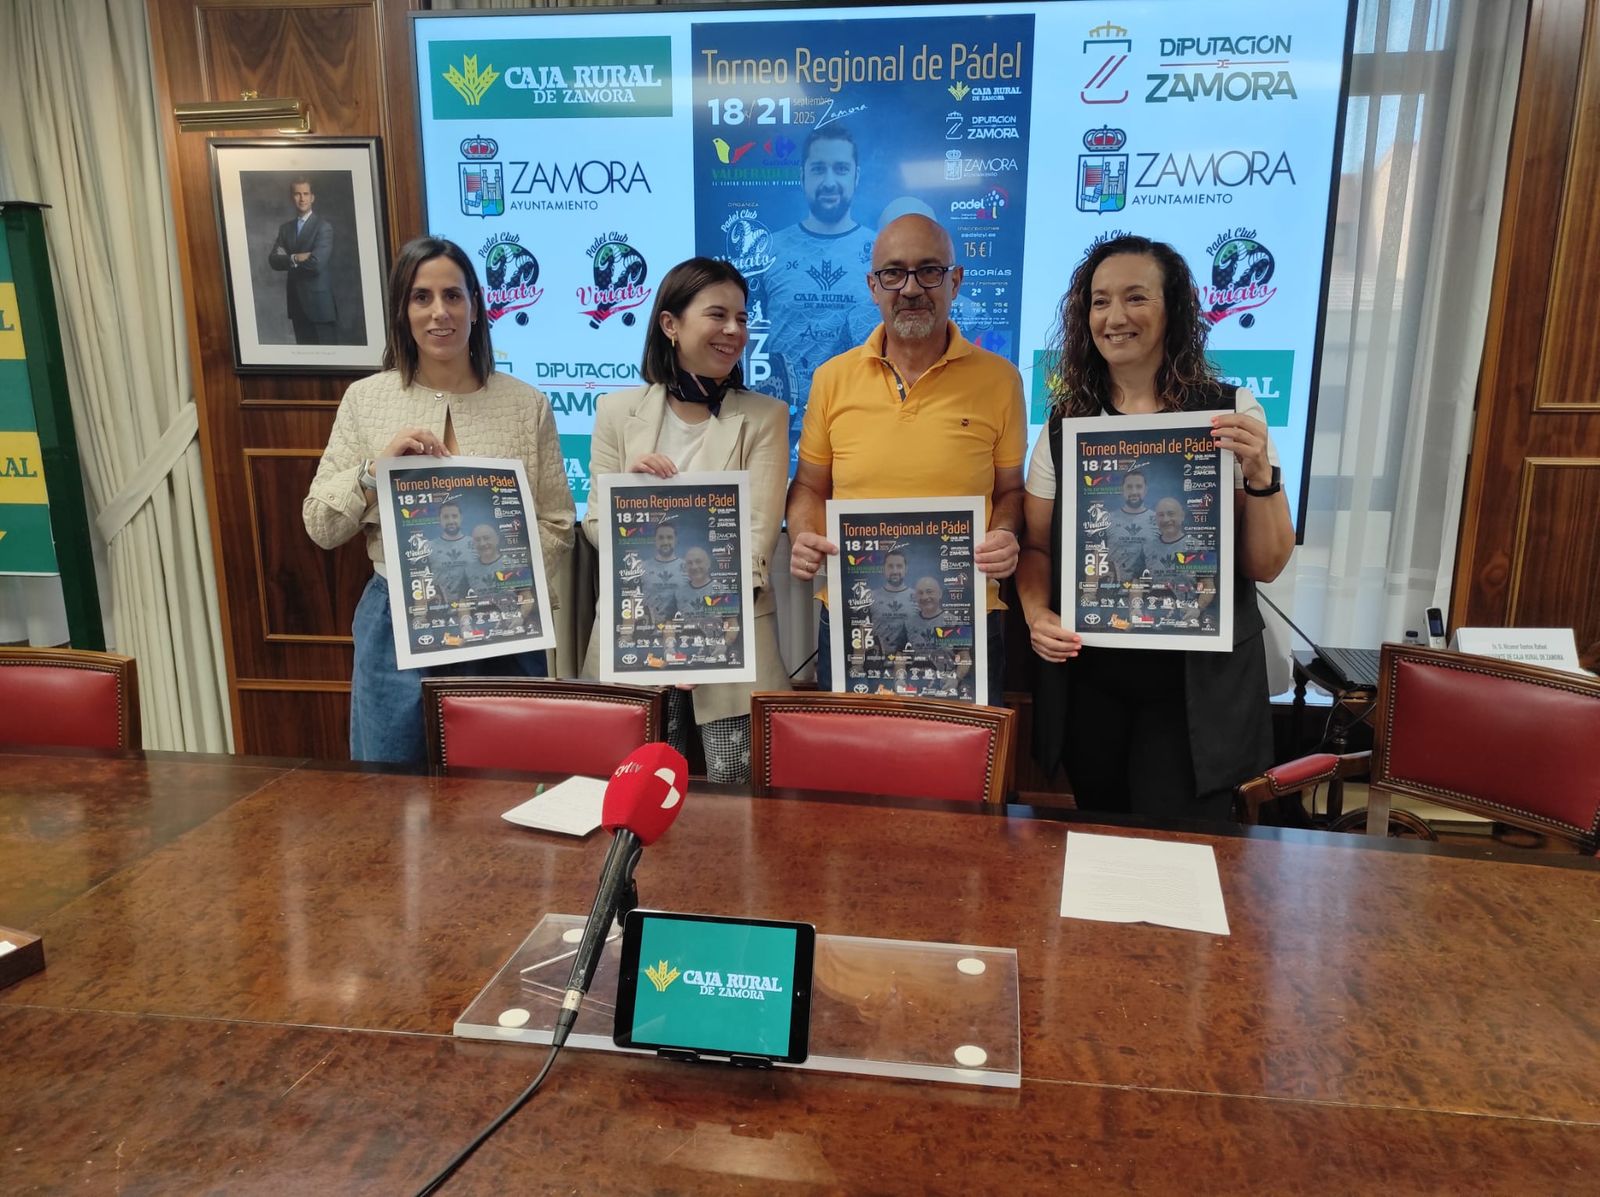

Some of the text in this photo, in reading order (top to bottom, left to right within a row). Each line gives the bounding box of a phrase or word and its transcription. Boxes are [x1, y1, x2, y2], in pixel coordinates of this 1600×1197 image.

[701, 41, 1022, 92] Torneo Regional de Pádel
[504, 64, 662, 89] CAJA RURAL
[971, 86, 1022, 96] CAJA RURAL
[1145, 71, 1298, 103] ZAMORA
[533, 89, 636, 104] DE ZAMORA
[707, 97, 791, 126] 18 21
[793, 111, 816, 124] 2025
[967, 128, 1020, 140] ZAMORA
[964, 158, 1019, 172] ZAMORA
[1134, 150, 1297, 188] ZAMORA
[508, 160, 652, 194] ZAMORA
[510, 199, 599, 211] AYUNTAMIENTO
[951, 198, 985, 212] padel
[1131, 193, 1234, 206] AYUNTAMIENTO
[721, 211, 740, 233] Padel
[478, 231, 521, 258] Padel Club
[585, 231, 629, 259] Padel Club
[964, 241, 977, 258] 15
[1205, 227, 1258, 256] Padel Club
[963, 267, 1013, 277] EGORÍAS
[481, 281, 544, 304] iriato
[575, 282, 652, 306] Viriato
[1080, 437, 1216, 458] Torneo Regional de Pádel
[1082, 460, 1099, 471] 18
[1102, 459, 1118, 471] 21
[394, 475, 516, 492] Torneo Regional de Pádel
[398, 494, 415, 506] 18
[417, 493, 433, 503] 21
[614, 492, 736, 511] Torneo Regional de Pádel
[616, 513, 632, 523] 18
[635, 512, 650, 522] 21
[843, 520, 970, 539] Torneo Regional de Pádel
[845, 540, 862, 551] 18
[865, 540, 879, 551] 21
[682, 970, 783, 993] CAJA RURAL
[699, 985, 766, 1000] DE ZAMORA
